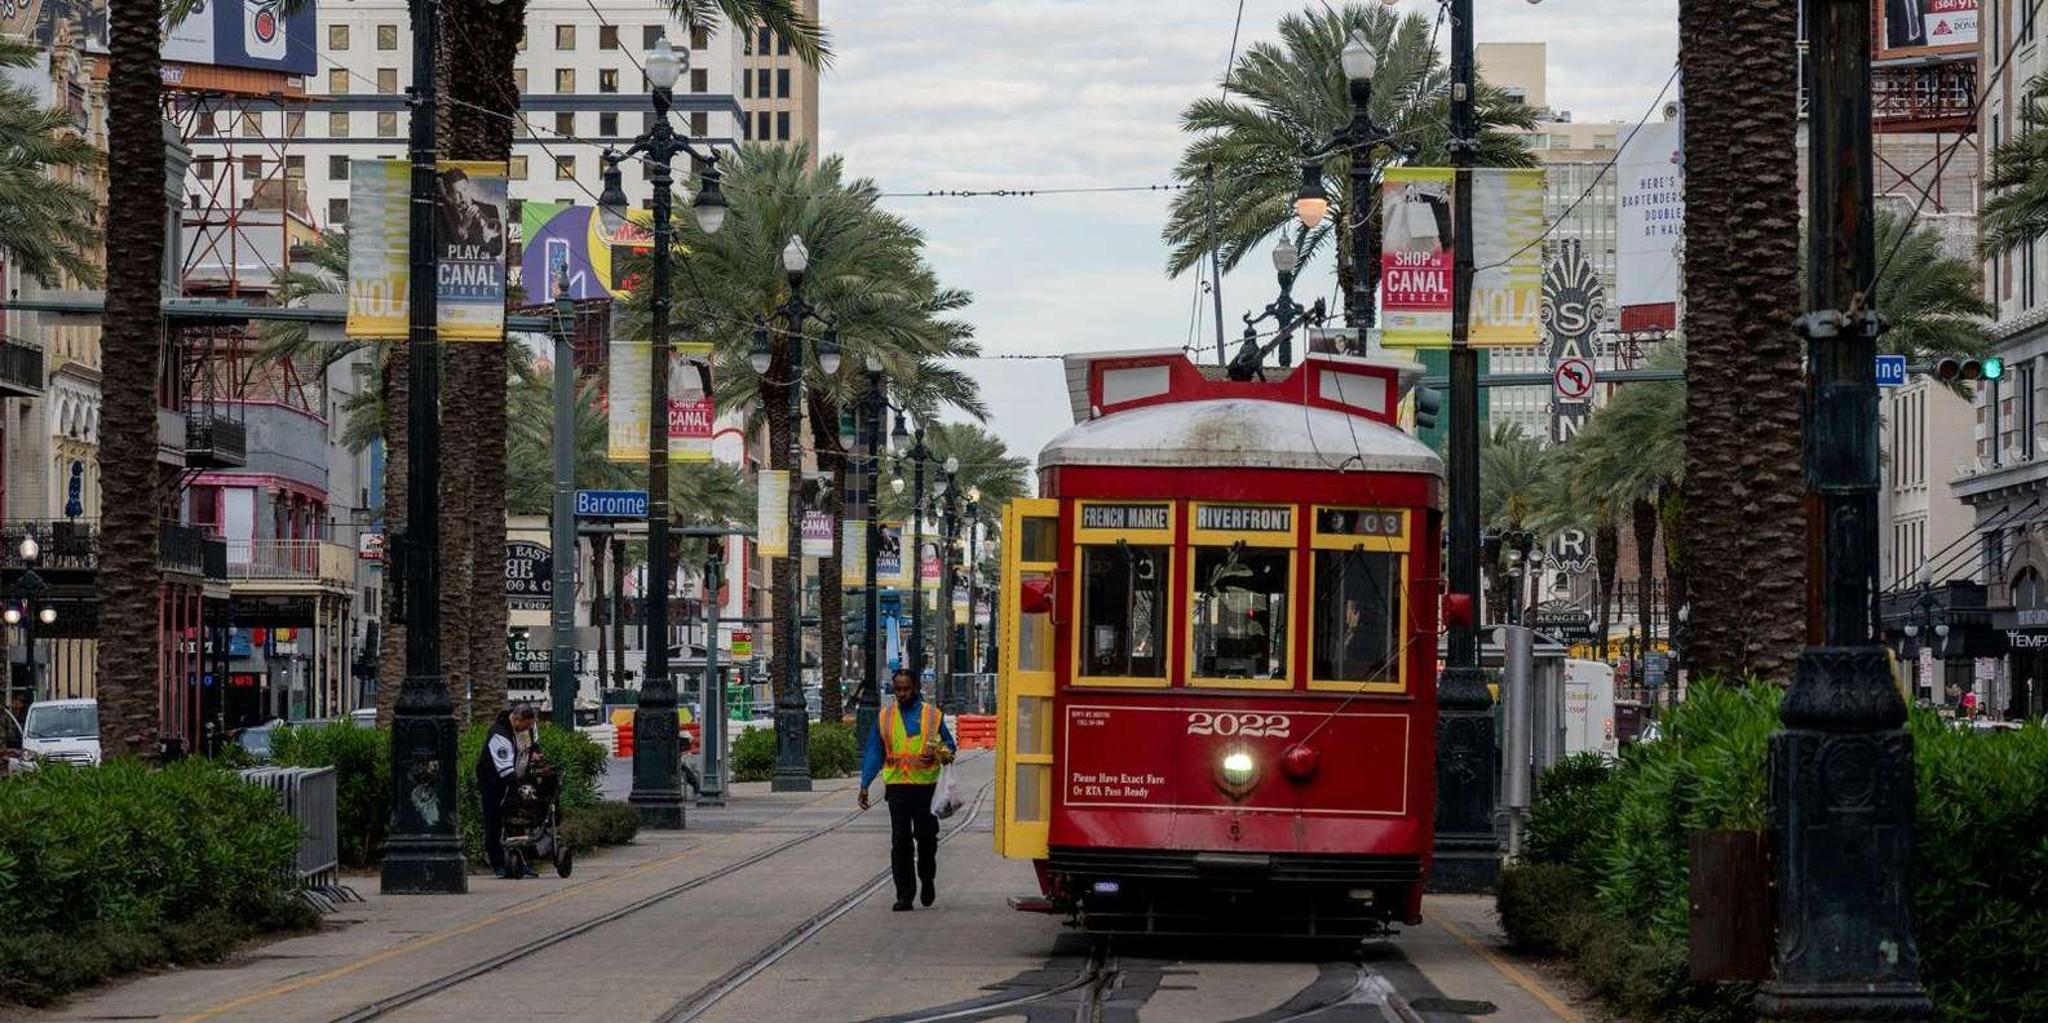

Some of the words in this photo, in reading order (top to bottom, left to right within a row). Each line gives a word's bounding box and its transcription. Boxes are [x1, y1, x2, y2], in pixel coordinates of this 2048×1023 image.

[1645, 207, 1681, 221] DOUBLE
[448, 244, 480, 260] PLAY
[1395, 250, 1431, 266] SHOP
[438, 263, 499, 286] CANAL
[1387, 270, 1448, 293] CANAL
[1387, 292, 1448, 302] STREET
[1468, 287, 1541, 328] NOLA
[668, 411, 709, 426] CANAL
[578, 492, 645, 514] Baronne
[1083, 506, 1124, 528] FRENCH
[1197, 507, 1290, 530] RIVERFRONT
[516, 546, 551, 562] EASY
[515, 651, 550, 661] CAS
[1187, 712, 1290, 738] 2022
[1073, 772, 1097, 783] Please
[1099, 772, 1119, 784] Have
[1121, 773, 1145, 784] Exact
[1146, 774, 1166, 785] Fare
[1073, 785, 1083, 796] Or
[1104, 786, 1122, 797] Pass
[1124, 786, 1150, 799] Ready
